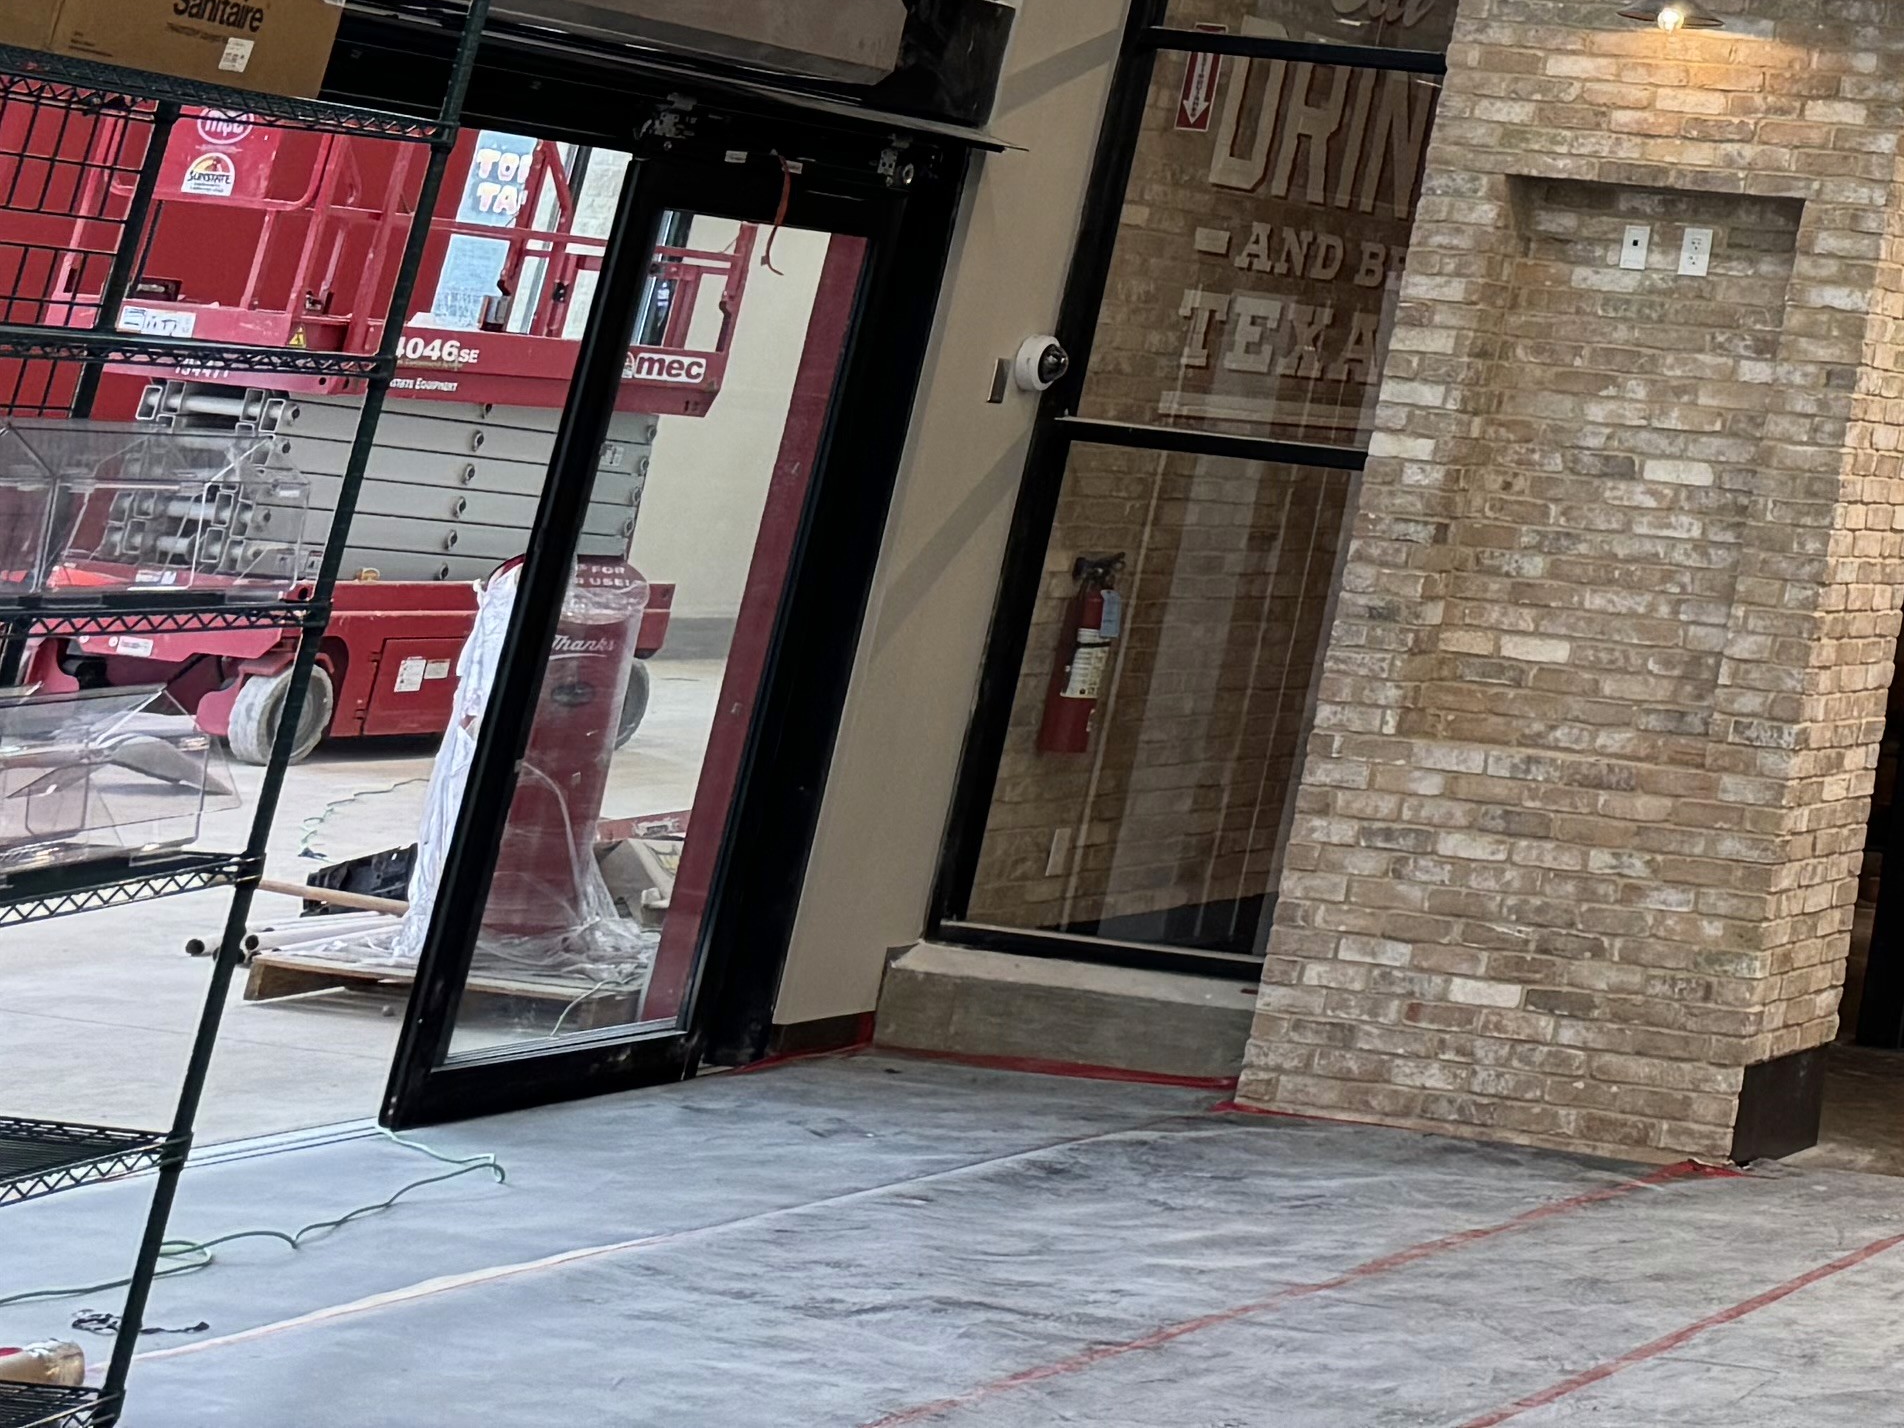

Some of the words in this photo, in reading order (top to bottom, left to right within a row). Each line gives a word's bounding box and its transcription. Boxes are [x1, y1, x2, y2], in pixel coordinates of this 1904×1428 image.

[1234, 221, 1344, 281] AND
[636, 356, 703, 380] mec
[592, 565, 626, 575] FOR
